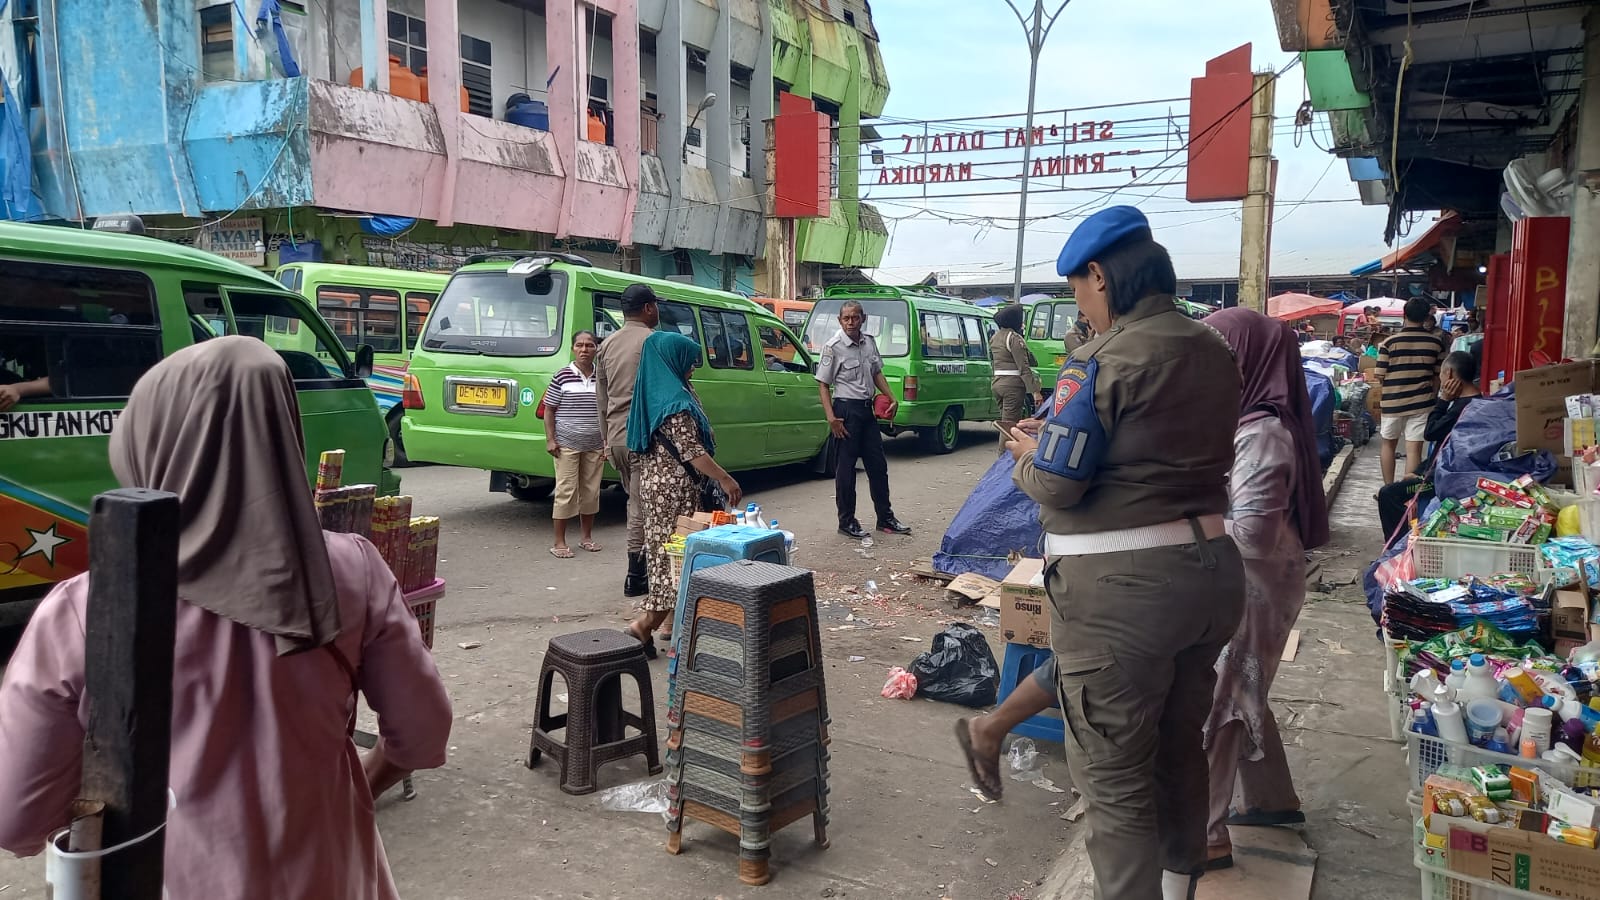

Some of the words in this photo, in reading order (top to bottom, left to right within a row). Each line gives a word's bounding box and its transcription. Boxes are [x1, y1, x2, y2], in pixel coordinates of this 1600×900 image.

[211, 229, 260, 243] AYAH
[459, 386, 470, 398] DE
[522, 391, 532, 402] 18
[1043, 424, 1088, 469] TI
[1015, 602, 1042, 616] Rinso
